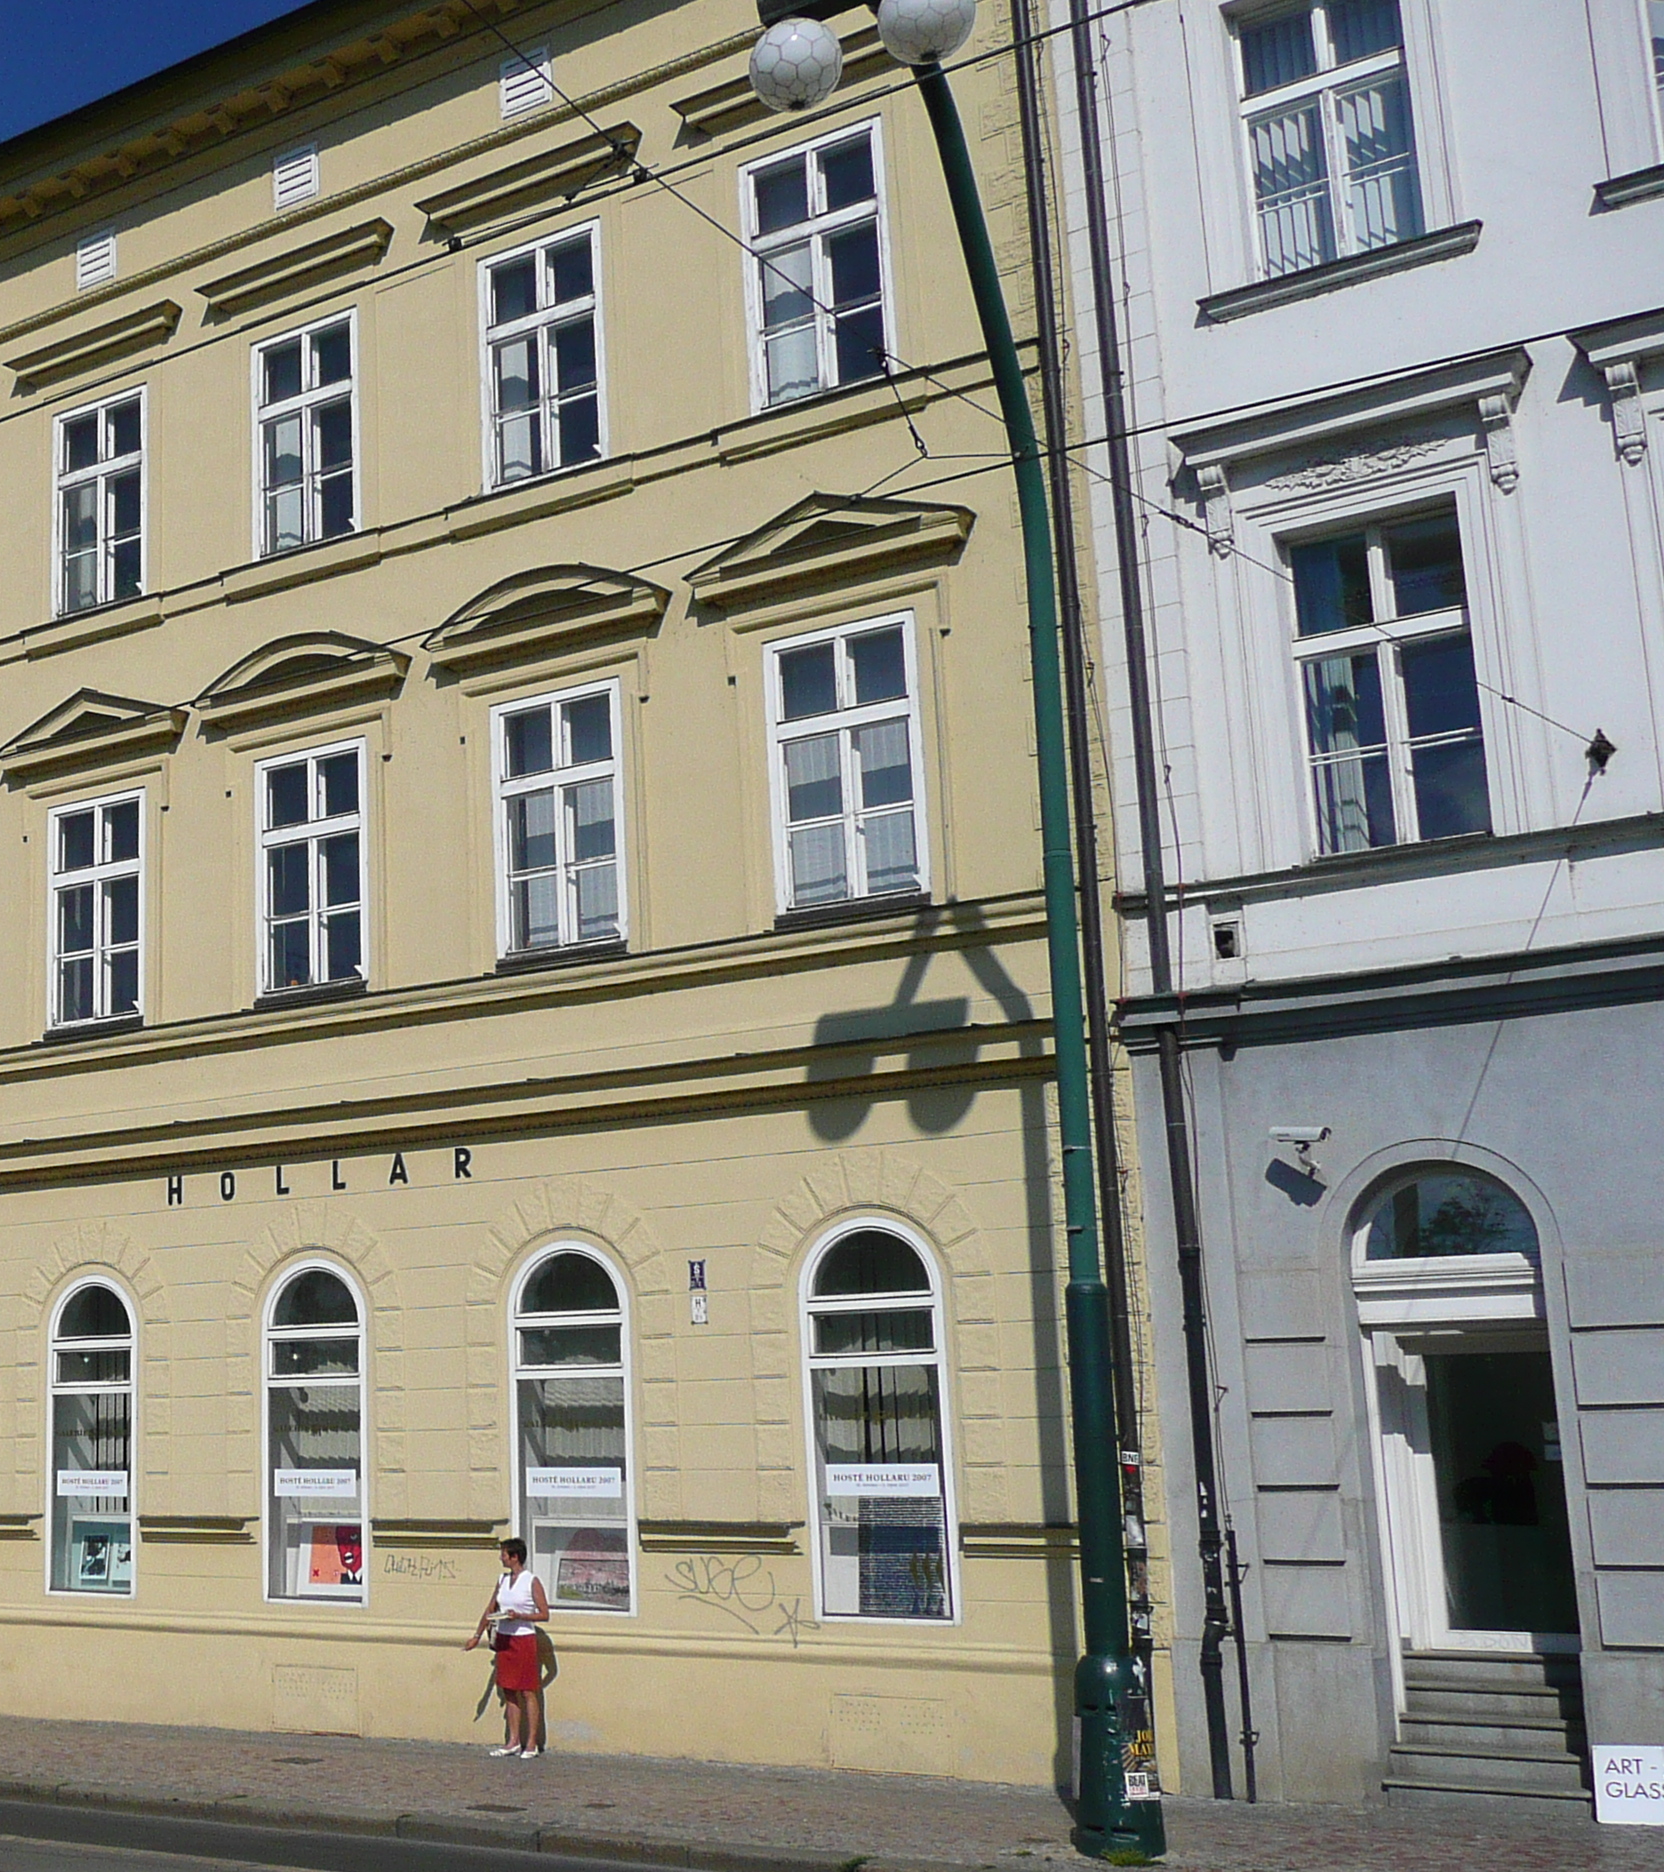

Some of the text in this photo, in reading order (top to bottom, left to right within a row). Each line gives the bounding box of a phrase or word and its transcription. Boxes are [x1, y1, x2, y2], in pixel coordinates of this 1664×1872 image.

[168, 1147, 472, 1206] HOLLAR
[532, 1475, 615, 1484] HOSTÉ HOLLARU 2007
[833, 1473, 932, 1482] HOSTÉ HOLLARU 2007
[1604, 1758, 1643, 1775] ART
[1605, 1781, 1664, 1800] GLAS
